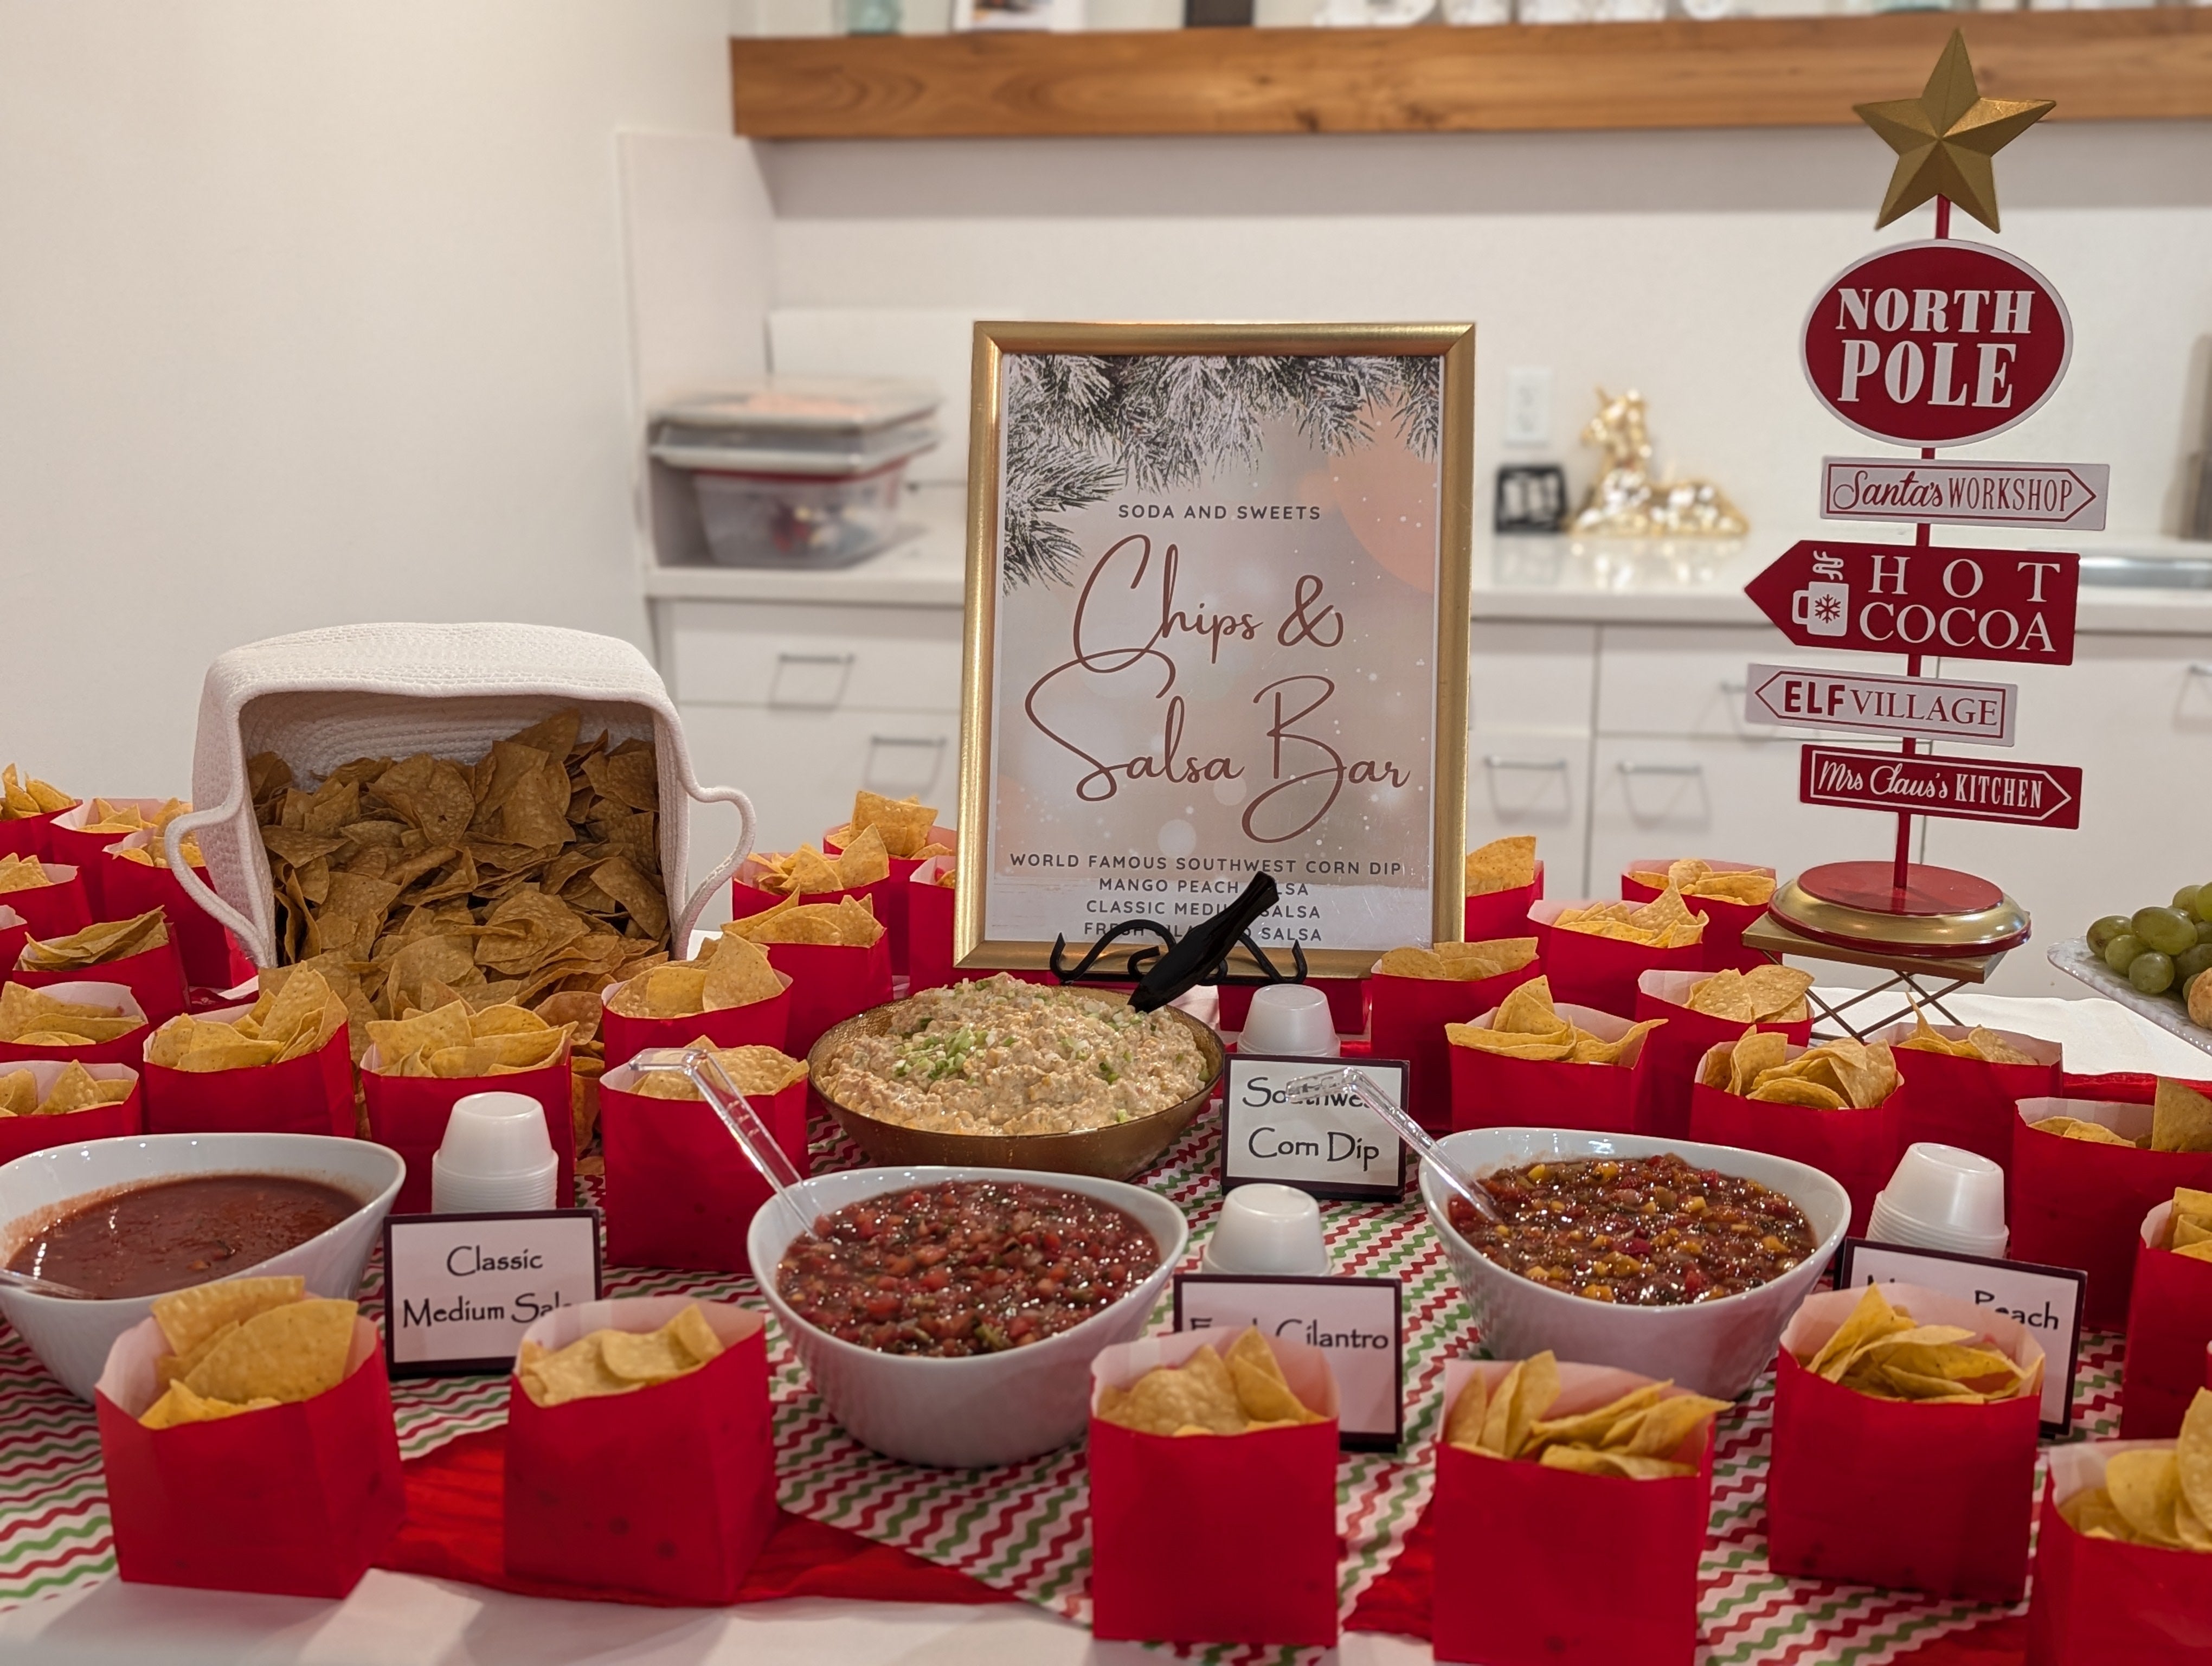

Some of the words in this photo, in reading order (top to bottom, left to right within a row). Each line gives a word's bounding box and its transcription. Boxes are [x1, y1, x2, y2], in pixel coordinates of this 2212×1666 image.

[1835, 288, 2035, 334] NORTH
[1837, 339, 2017, 408] POLE
[1118, 504, 1174, 518] SODA
[1184, 505, 1227, 519] AND
[1237, 505, 1320, 520] SWEETS
[1833, 470, 1943, 510] Santa's
[1948, 477, 2072, 512] WORKSHOP
[1073, 534, 1264, 674] Chips
[1277, 574, 1343, 648] &
[1860, 601, 2056, 652] COCOA
[1784, 680, 1846, 716] ELF
[1850, 689, 1997, 726] VILLAGE
[1024, 648, 1245, 802] Salsa
[1241, 675, 1411, 844] Bar
[1818, 760, 1863, 791] Mrs
[1870, 762, 1948, 799] Claus's
[1954, 773, 2043, 809] KITCHEN
[1010, 853, 1079, 867] WORLD
[1089, 855, 1167, 870] FAMOUS
[1175, 856, 1296, 874] SOUTHWEST
[1306, 861, 1359, 874] CORN
[1369, 862, 1401, 875] DIP
[1099, 877, 1168, 892] MANGO
[1178, 880, 1238, 894] PEACH
[1086, 900, 1165, 914] CLASSIC
[1174, 902, 1227, 917] MEDI
[1261, 904, 1321, 920] SALSA
[1261, 927, 1322, 942] SALSA
[1248, 1127, 1319, 1158] Corn
[1327, 1131, 1379, 1172] Dip
[446, 1245, 543, 1277] Classic
[403, 1296, 505, 1329] Medium
[511, 1291, 573, 1323] Sal
